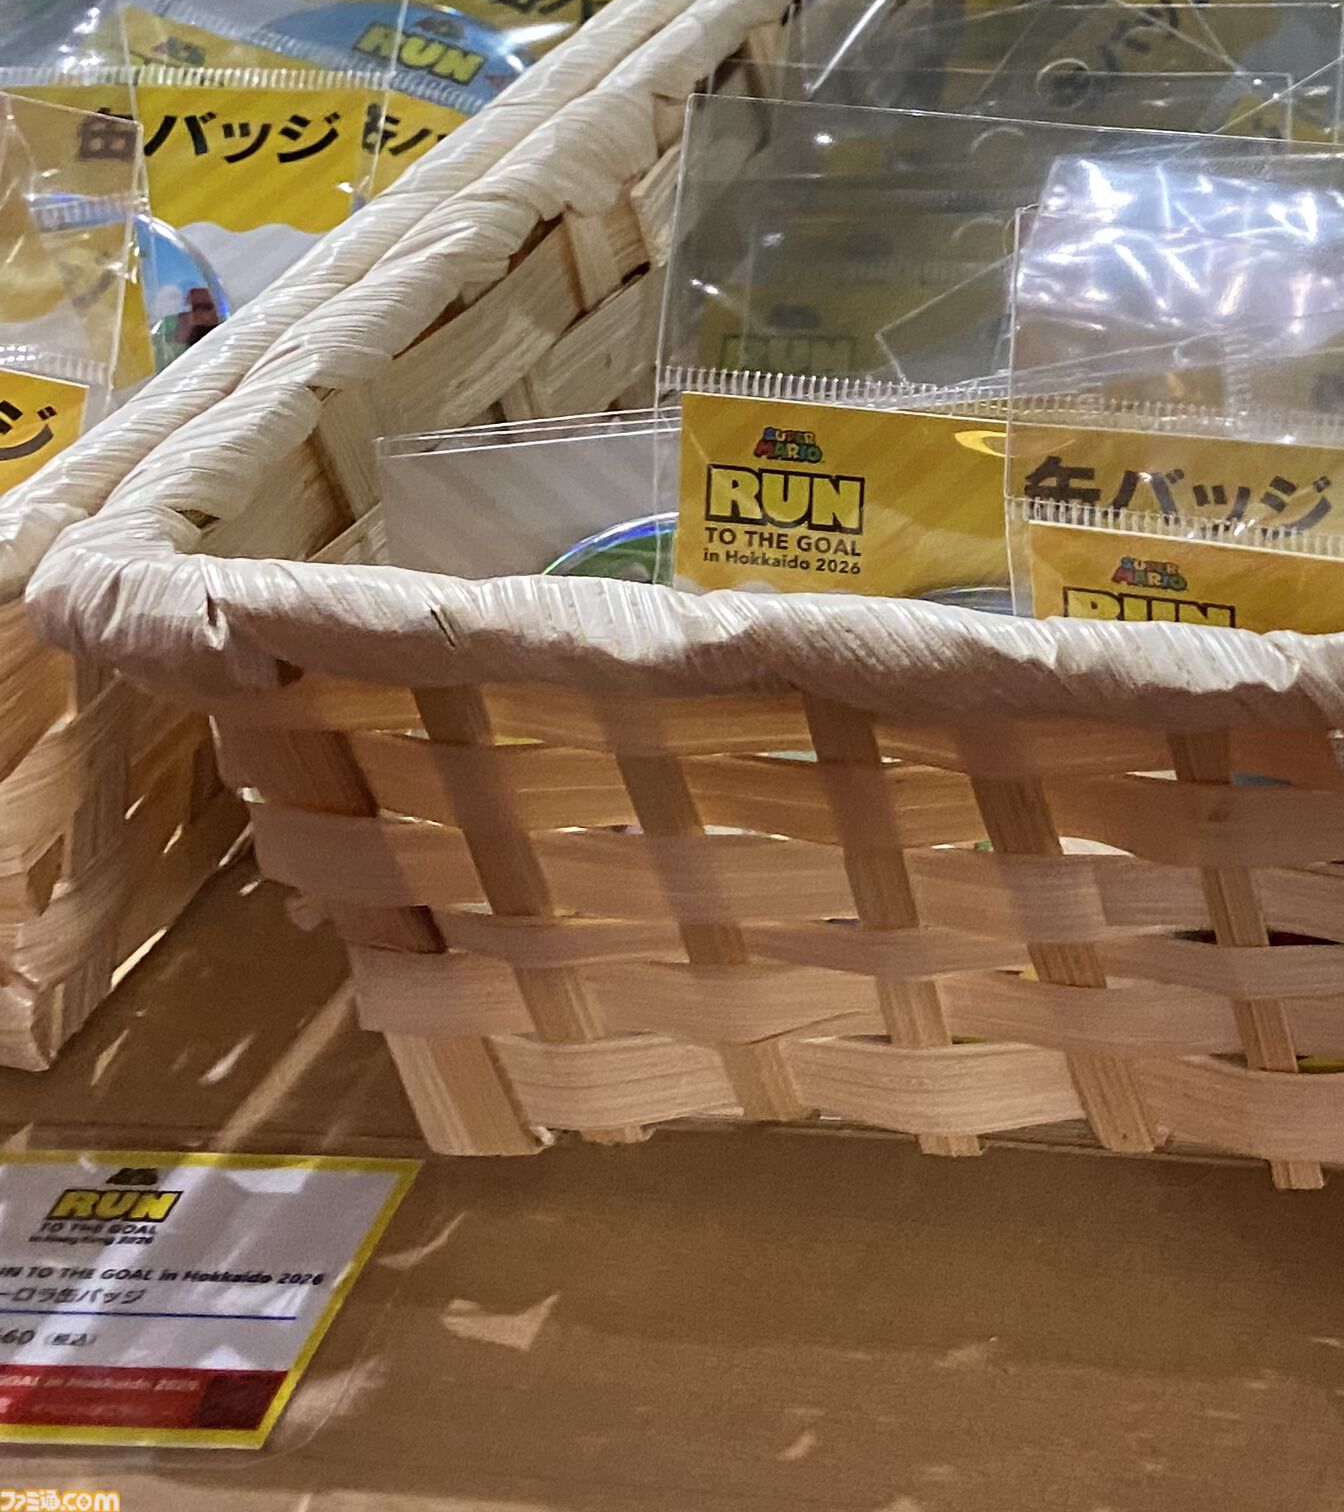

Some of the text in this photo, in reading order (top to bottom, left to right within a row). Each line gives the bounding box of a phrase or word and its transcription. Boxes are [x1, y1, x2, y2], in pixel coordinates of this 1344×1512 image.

[353, 21, 488, 86] RUN
[753, 440, 824, 464] MARIO
[705, 463, 865, 535] RUN
[1025, 456, 1332, 539] 缶バッジ
[705, 526, 862, 557] TO THE GOAL
[704, 548, 861, 575] in Hokkaido 2026
[47, 1188, 183, 1223] RUN
[27, 1267, 54, 1279] TO
[59, 1267, 94, 1280] THE
[100, 1268, 151, 1280] GOAL
[159, 1269, 178, 1281] in
[184, 1271, 273, 1284] Hokkaido
[276, 1272, 325, 1286] 2026
[0, 1329, 36, 1345] 60
